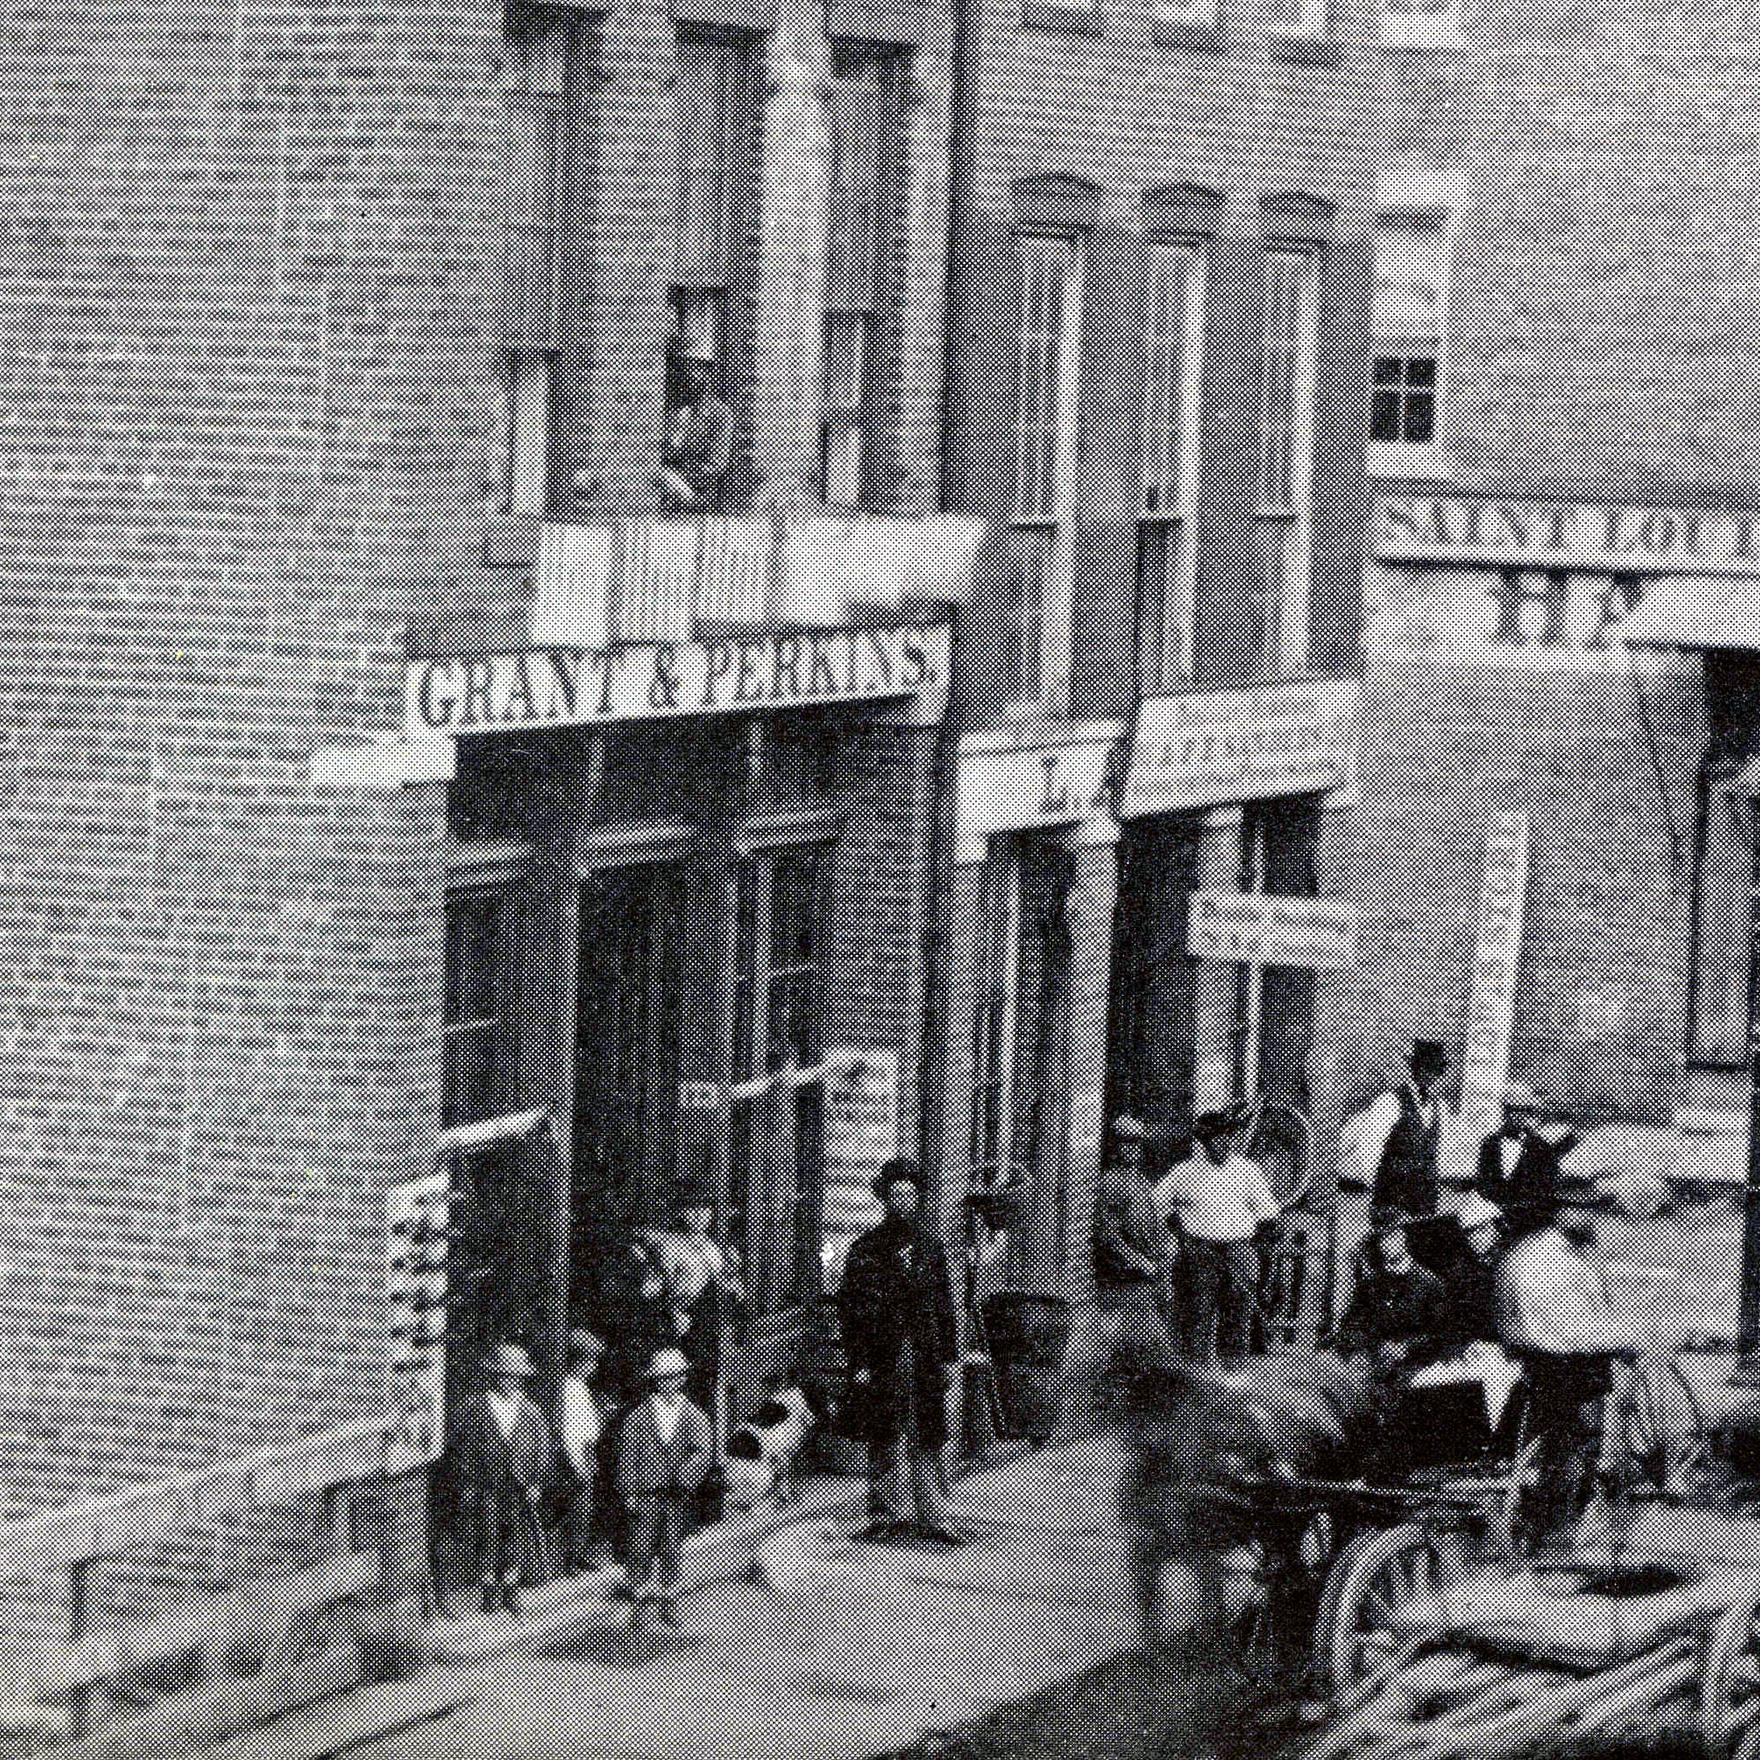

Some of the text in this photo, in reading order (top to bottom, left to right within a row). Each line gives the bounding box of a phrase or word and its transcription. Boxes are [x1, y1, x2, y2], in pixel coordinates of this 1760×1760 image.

[1384, 501, 1577, 549] SAINT
[418, 651, 625, 728] GRANT
[648, 643, 681, 711] &
